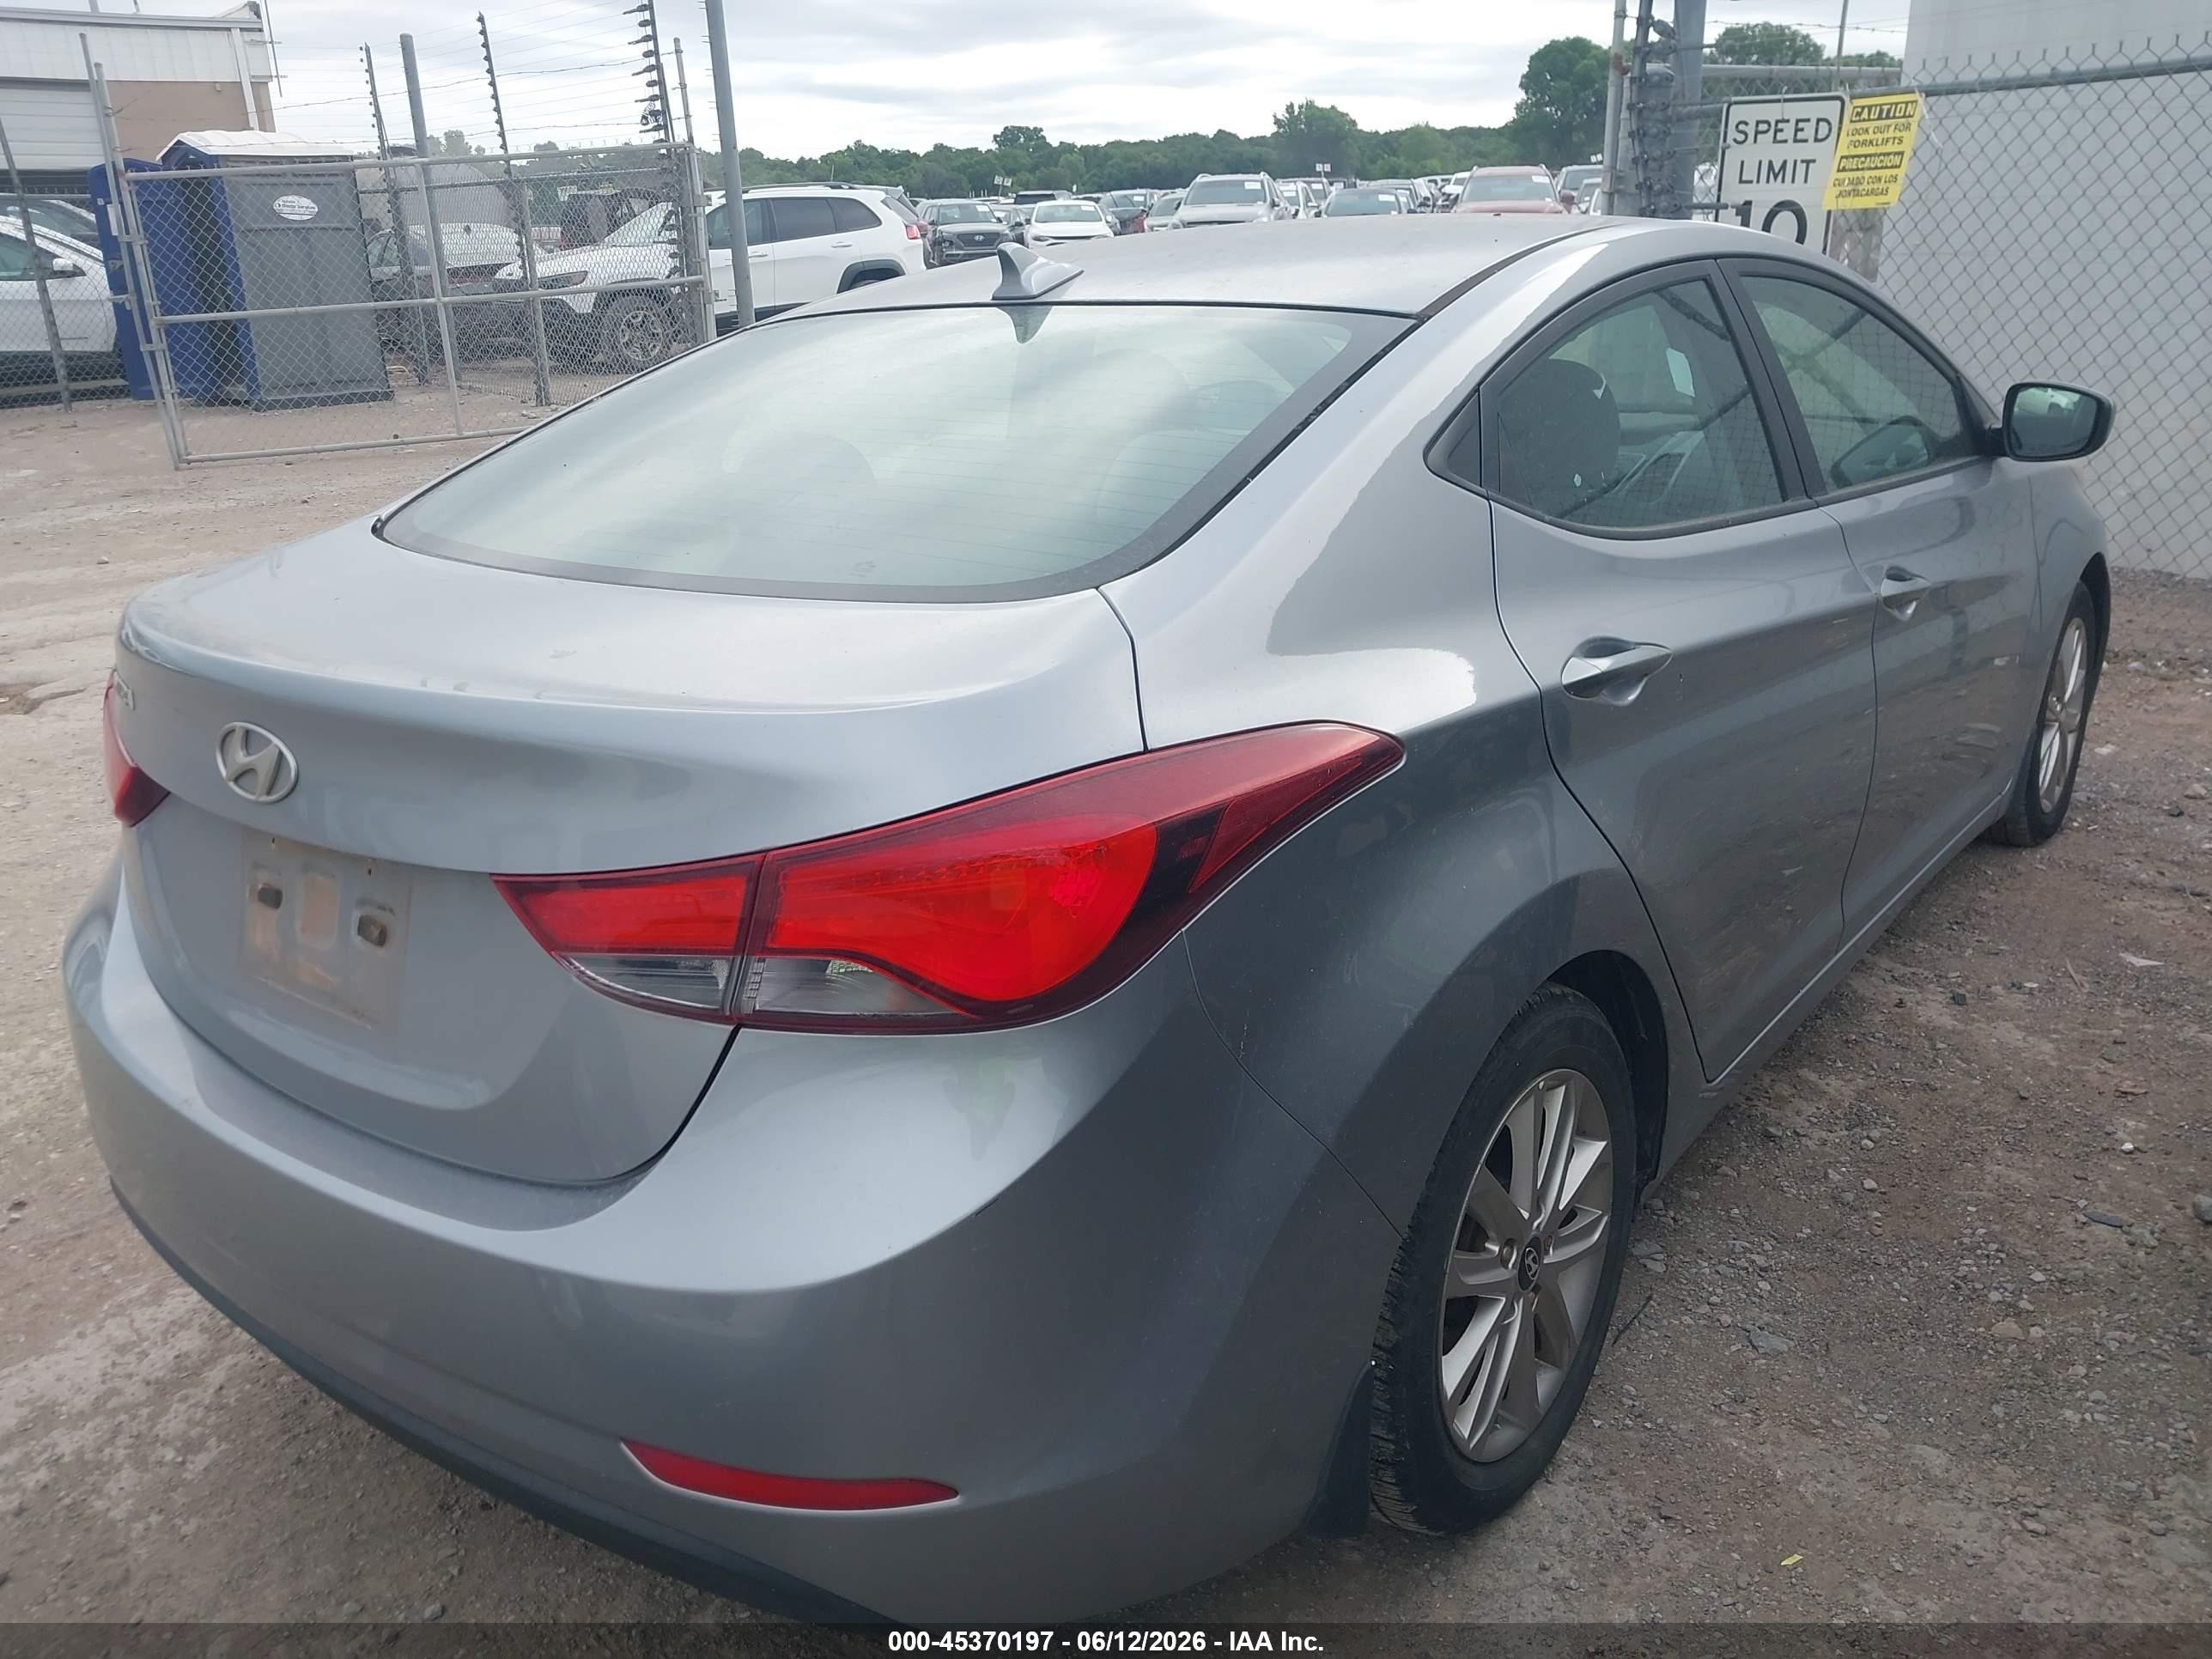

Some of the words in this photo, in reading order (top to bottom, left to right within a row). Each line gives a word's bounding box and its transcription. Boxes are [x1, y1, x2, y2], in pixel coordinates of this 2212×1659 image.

[1851, 103, 1916, 121] CAUTION
[1732, 118, 1832, 144] SPEED
[1873, 124, 1892, 135] OUT
[1893, 123, 1911, 133] FOR
[1847, 136, 1904, 149] FORKLIFTS
[1738, 159, 1816, 184] LIMIT
